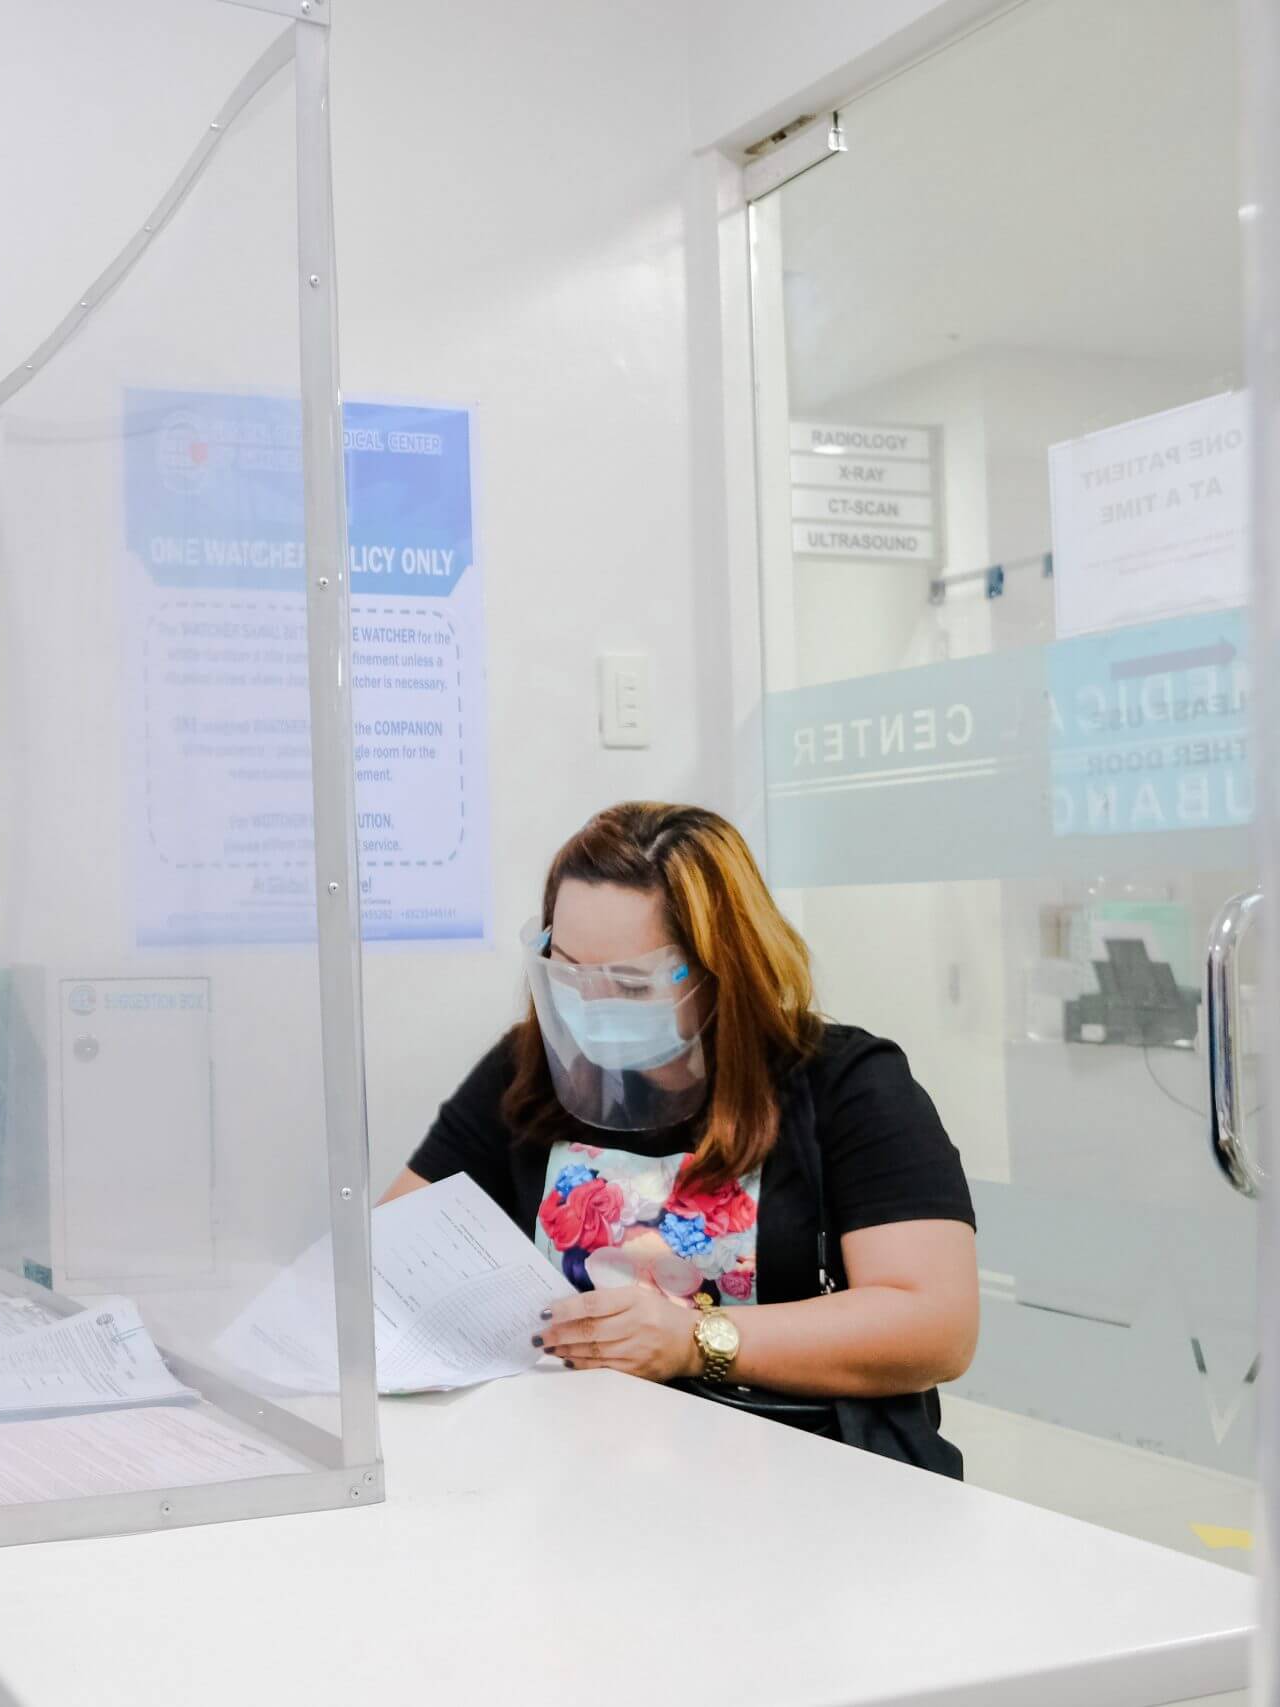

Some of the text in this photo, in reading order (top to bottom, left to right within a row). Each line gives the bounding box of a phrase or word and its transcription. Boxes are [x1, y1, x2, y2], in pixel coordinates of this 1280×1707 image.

[389, 432, 443, 456] CENTER
[811, 429, 907, 451] RADIOLOGY
[839, 464, 885, 482] X-RAY
[828, 498, 900, 517] CT-SCAN
[808, 531, 918, 552] ULTRASOUND
[151, 536, 201, 566] ONE
[401, 547, 455, 577] ONLY
[361, 626, 417, 643] WATCHER
[417, 630, 433, 645] for
[434, 631, 451, 645] the
[401, 652, 434, 668] unless
[436, 656, 444, 668] a
[384, 674, 392, 689] is
[394, 676, 448, 694] necessary.
[355, 720, 443, 736] the COMPANION
[372, 747, 400, 760] room
[402, 744, 416, 760] for
[418, 745, 436, 760] the
[354, 768, 393, 782] ement.
